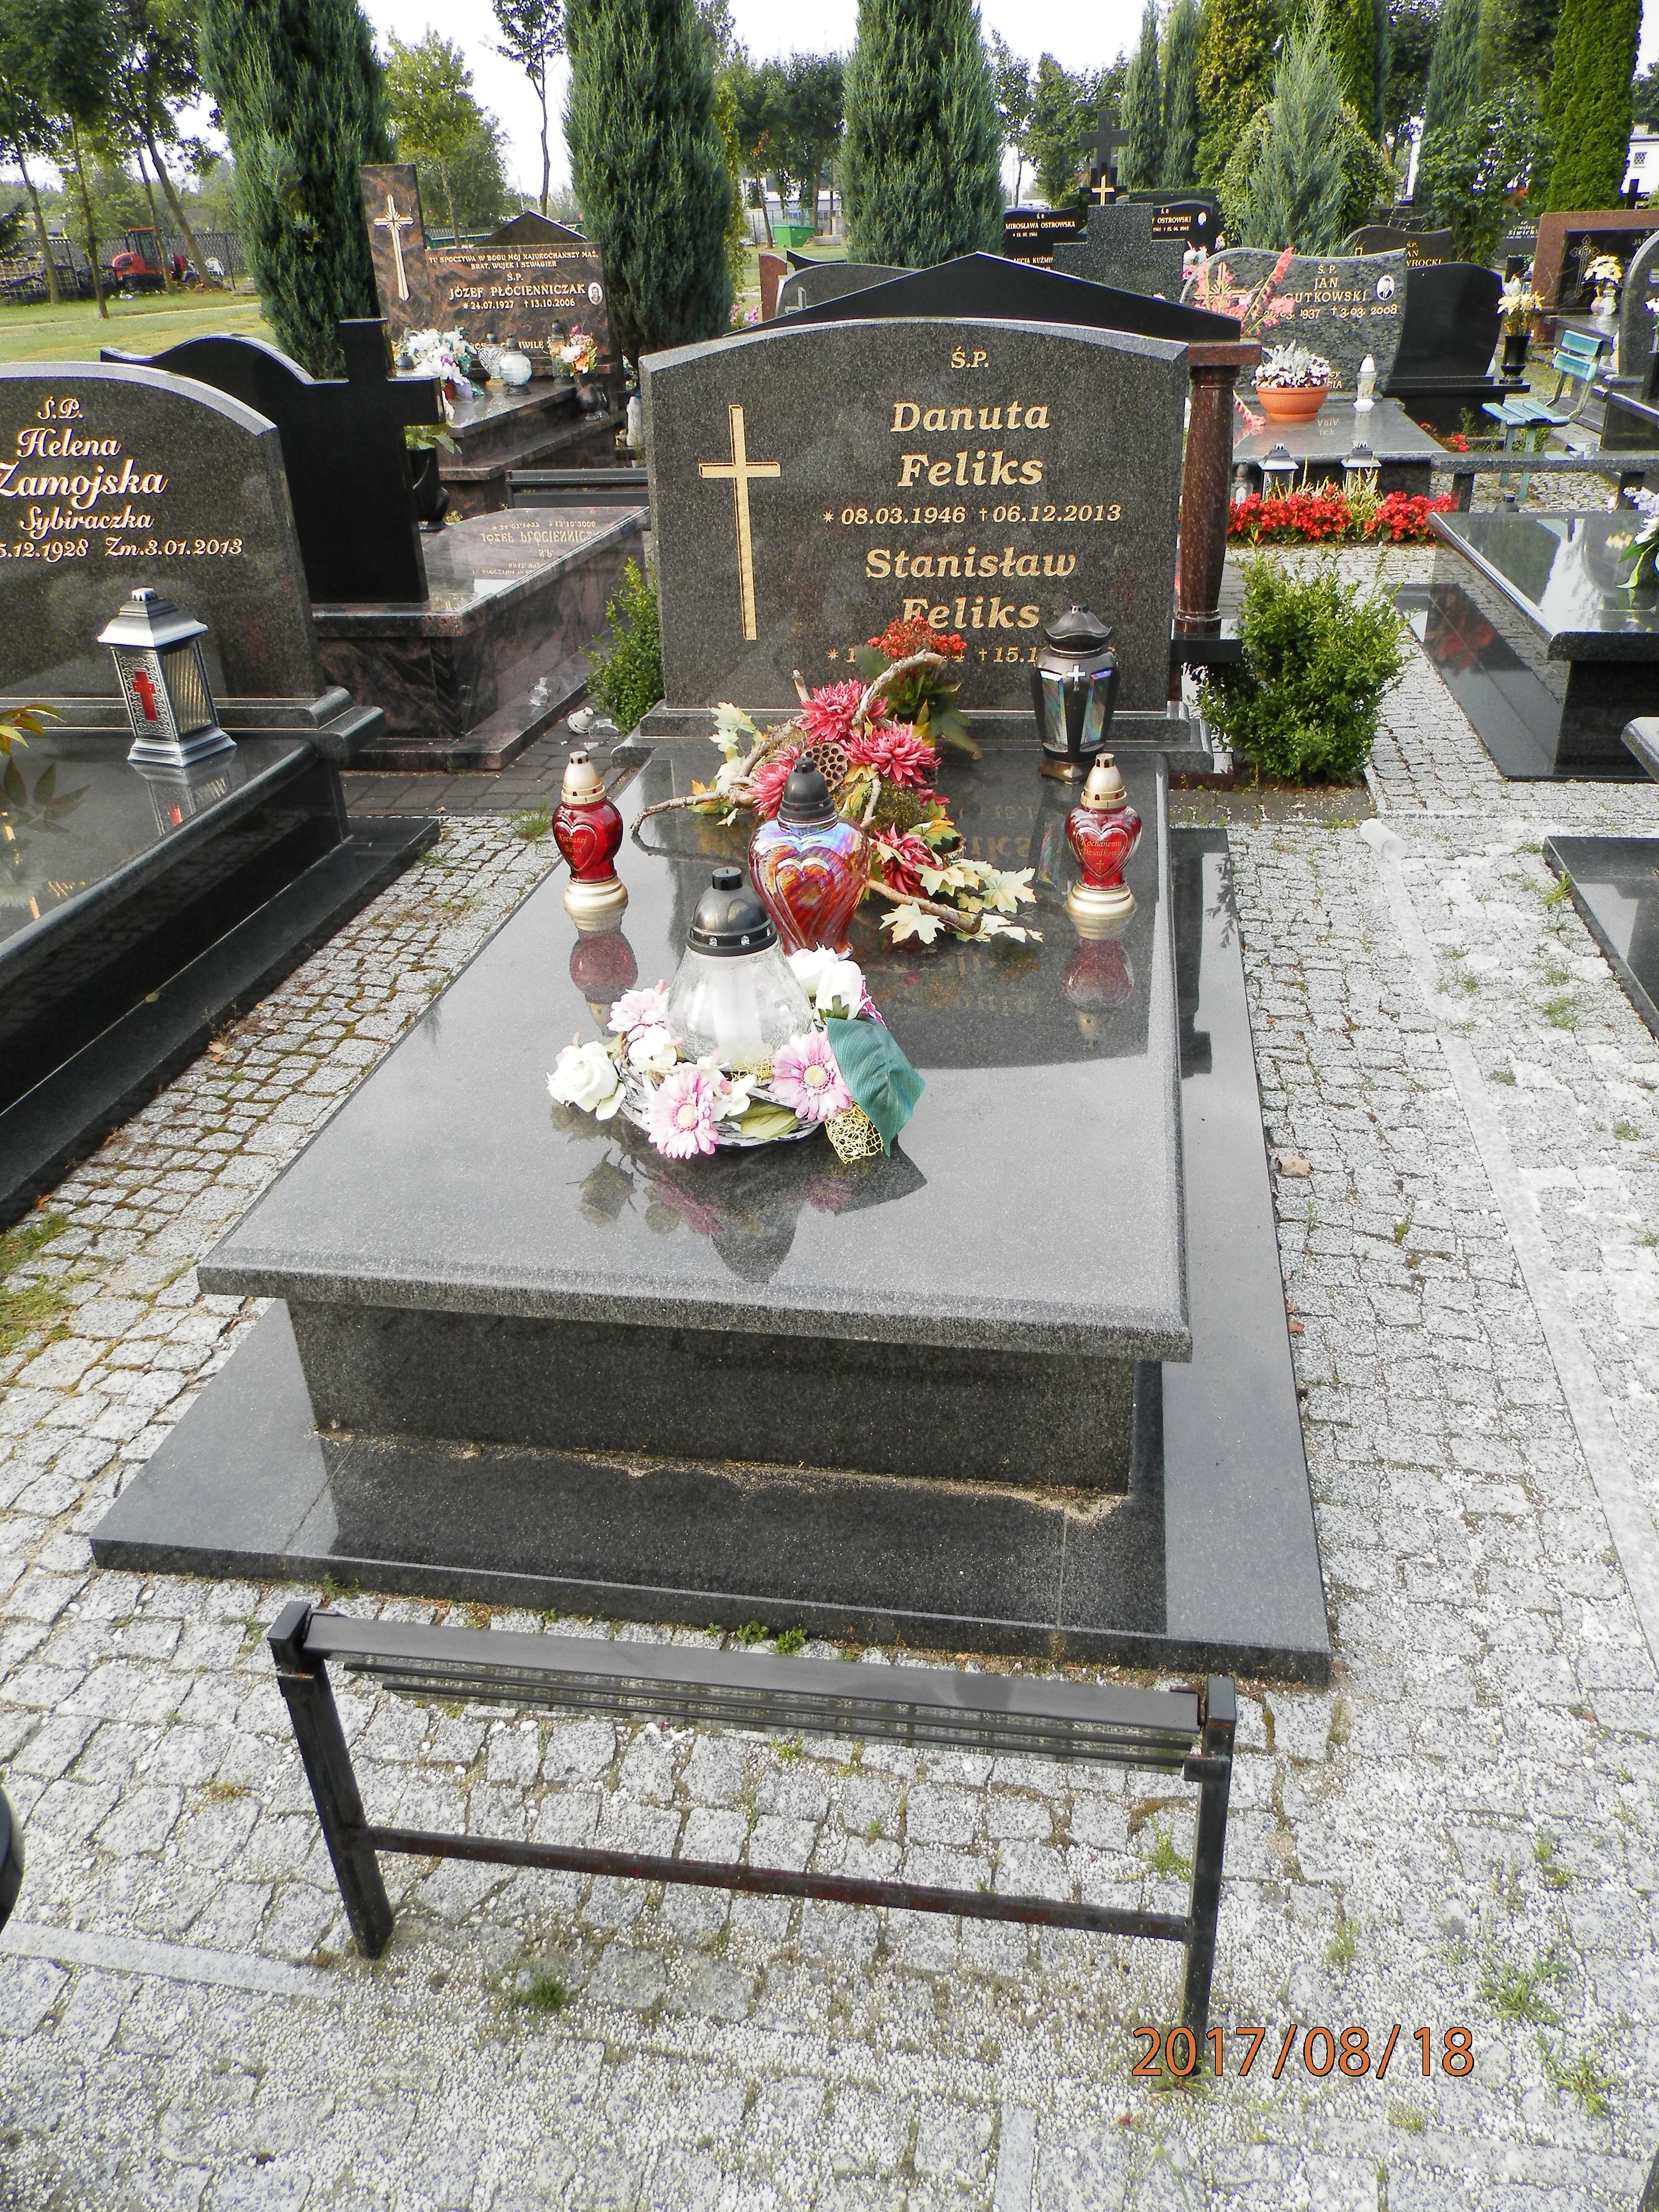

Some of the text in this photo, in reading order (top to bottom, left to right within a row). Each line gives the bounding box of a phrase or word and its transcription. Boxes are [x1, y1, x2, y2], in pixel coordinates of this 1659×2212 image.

[1157, 216, 1191, 224] OSTROWSKI
[440, 254, 477, 264] SPOCZYWA
[487, 253, 506, 262] BOGU
[508, 252, 521, 262] MÓJ
[507, 272, 524, 282] Ś.P.
[1313, 277, 1338, 291] JAN
[449, 283, 586, 300] JÓZEF PŁÓCIENNICZAK
[471, 298, 576, 310] 24.07.1927 13.10.2006
[1300, 308, 1320, 320] 1937
[1340, 307, 1366, 319] 3.03.
[1370, 304, 1397, 315] 2008
[950, 346, 989, 369] Ś.P.
[36, 396, 84, 420] Ś.P.
[890, 399, 1051, 433] Danuta
[15, 427, 121, 457] Helena
[897, 450, 1044, 487] Feliks
[0, 458, 168, 510] Zamojska
[20, 504, 154, 540] Sybiraczka
[841, 504, 1122, 526] 08.03.1946 06.12.2013
[866, 545, 1077, 578] Stanisław
[902, 595, 1041, 629] Feliks
[558, 833, 587, 845] Kochanej
[1081, 838, 1122, 848] Kochanemu
